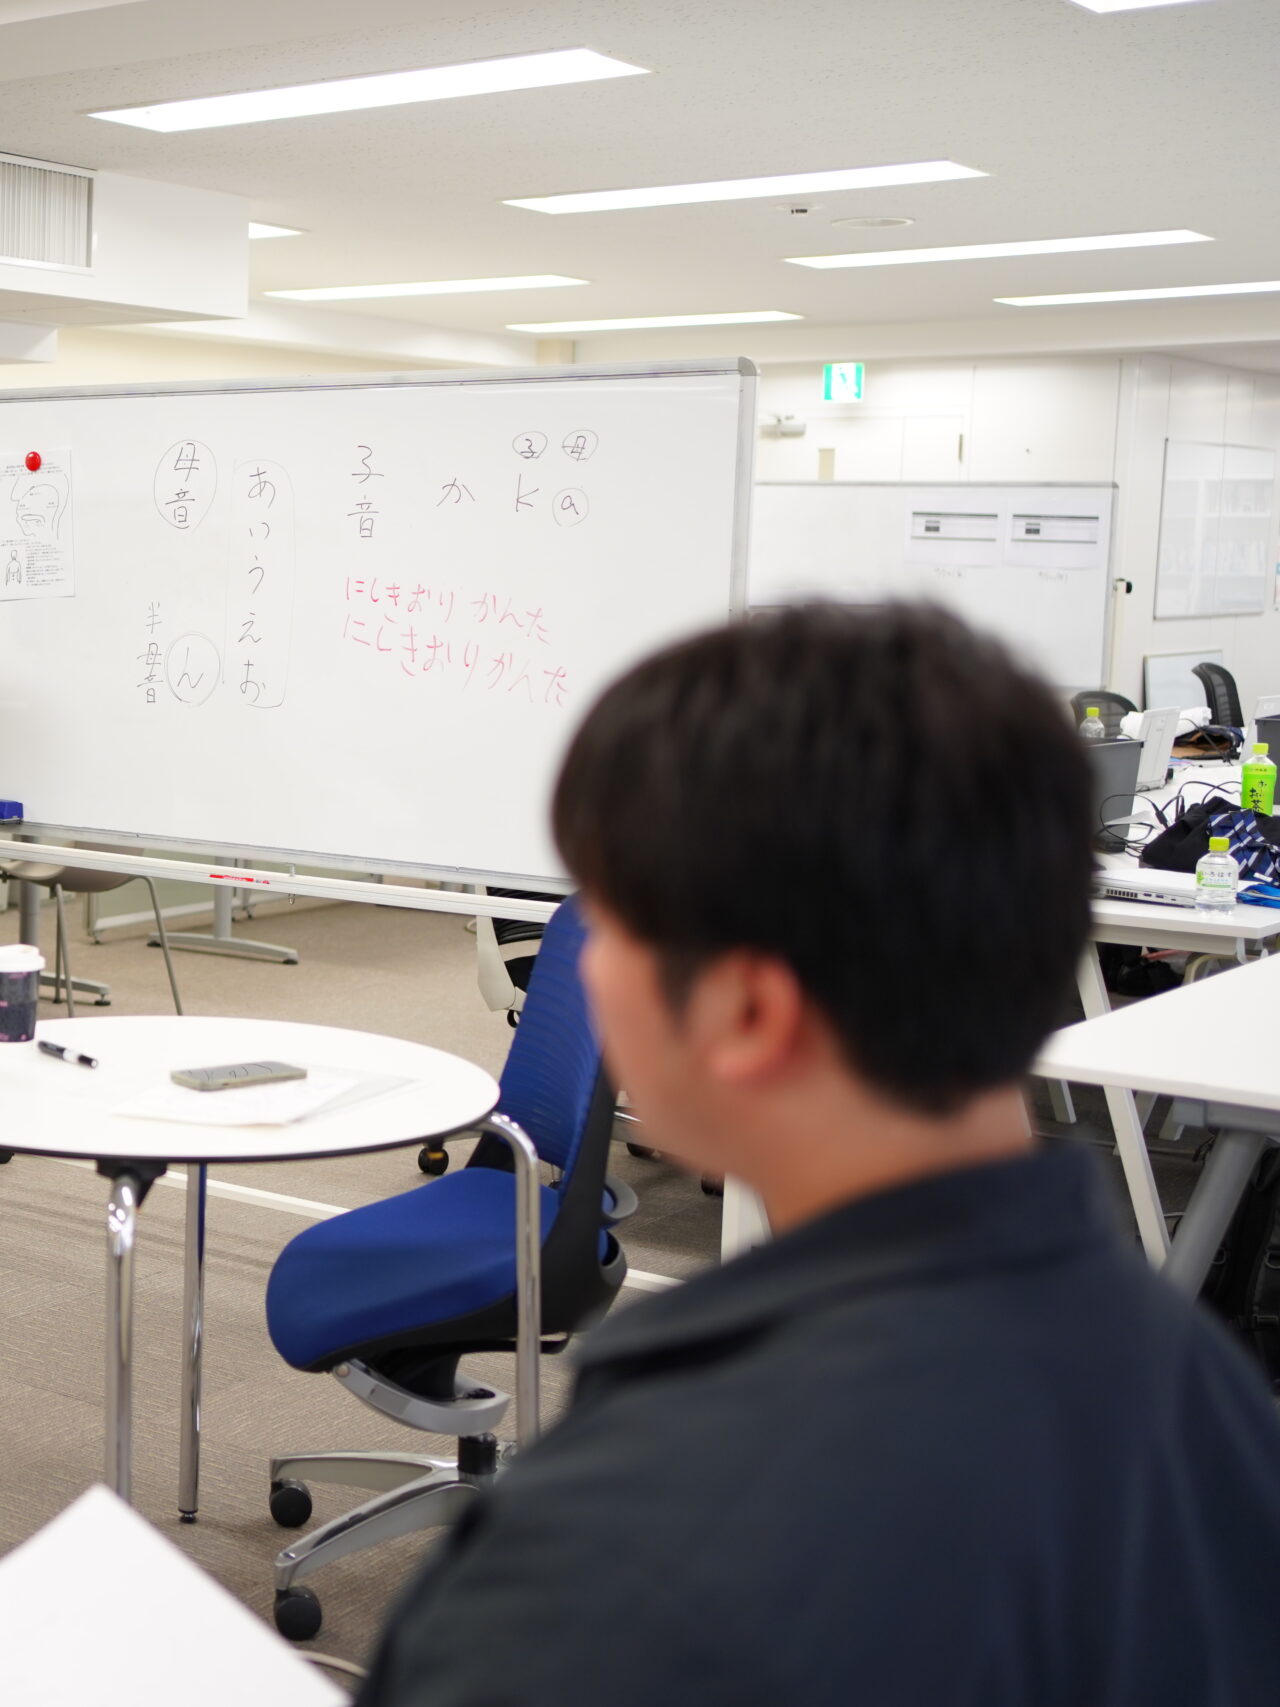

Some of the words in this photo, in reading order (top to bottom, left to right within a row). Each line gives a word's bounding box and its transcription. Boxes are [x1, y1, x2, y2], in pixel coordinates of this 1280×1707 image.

[165, 443, 200, 523] 母音
[347, 445, 384, 538] 子音
[437, 477, 475, 507] か
[238, 466, 275, 703] あいうえお
[177, 647, 204, 689] ん
